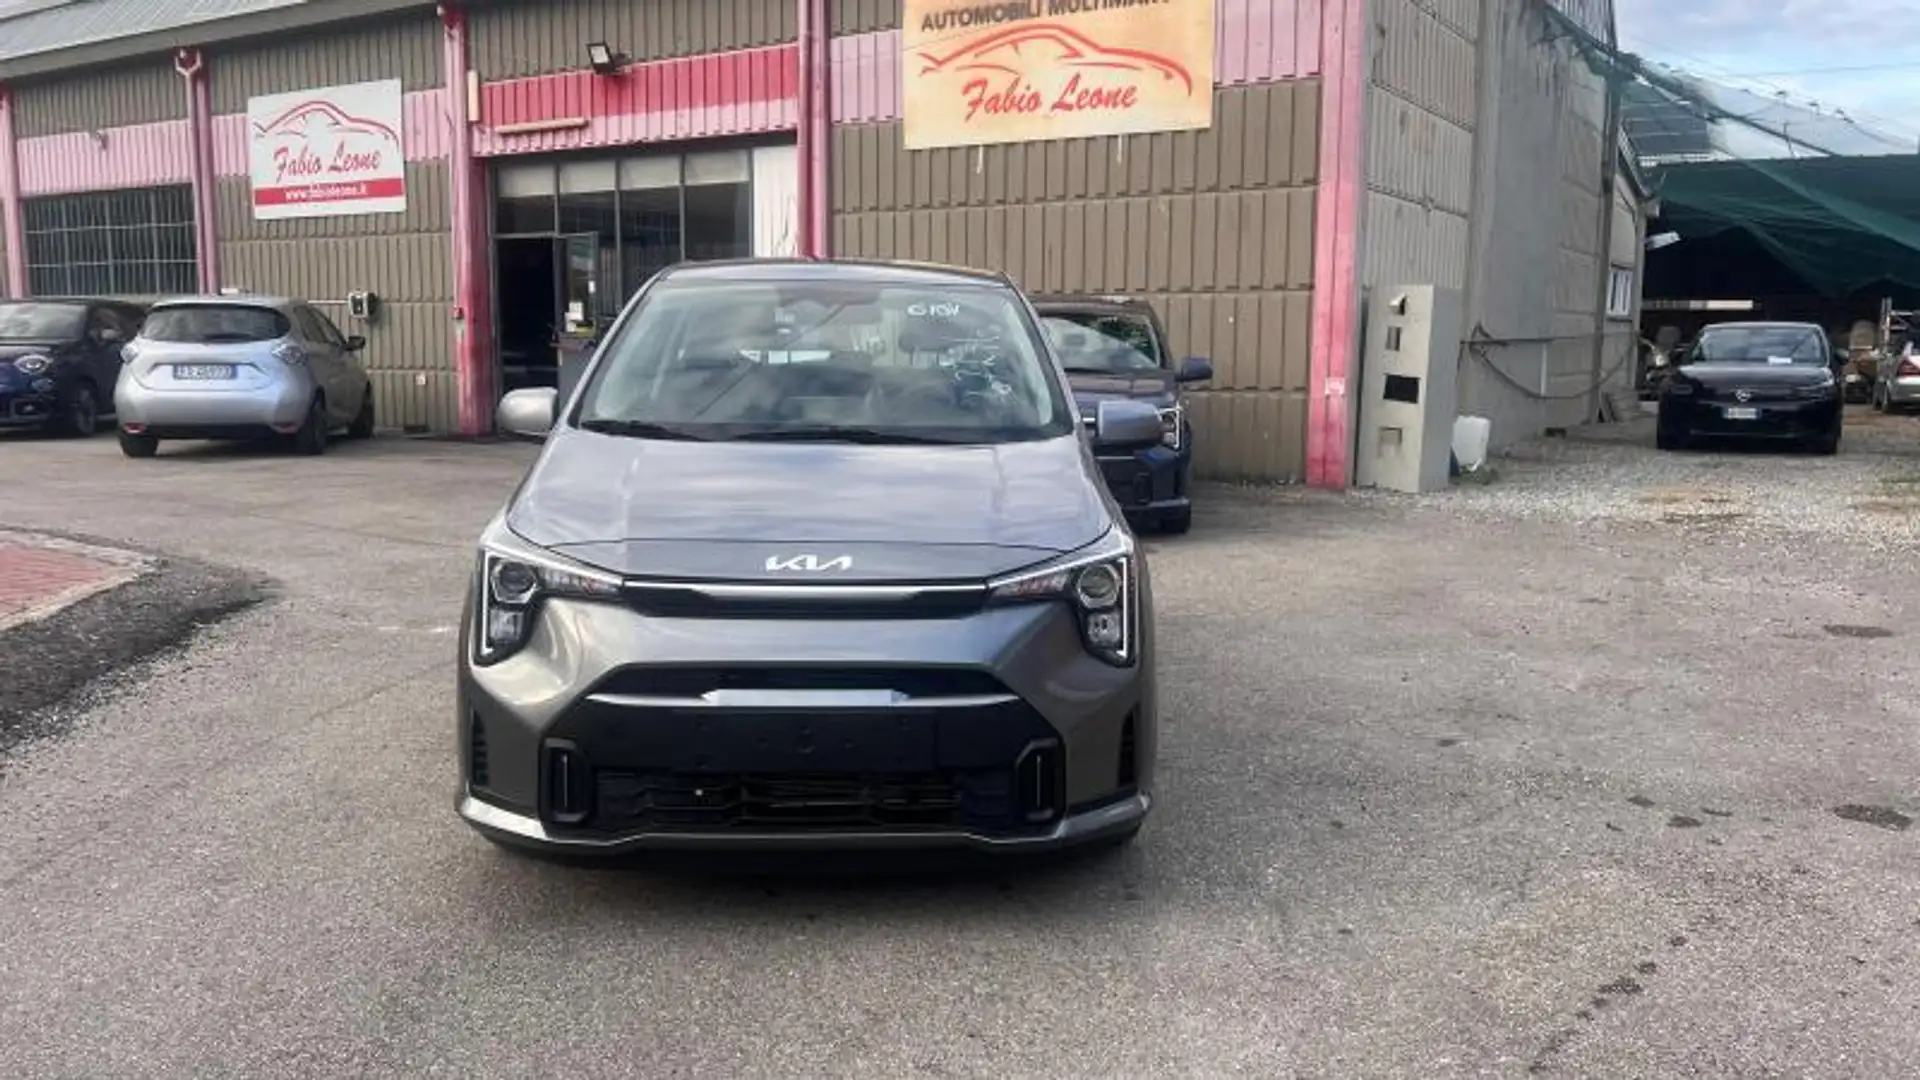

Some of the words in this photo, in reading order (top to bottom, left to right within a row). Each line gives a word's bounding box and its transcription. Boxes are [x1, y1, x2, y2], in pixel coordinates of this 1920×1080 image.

[921, 0, 1041, 32] AUTOMOBILI
[961, 76, 1043, 123] Fabio
[1050, 72, 1138, 112] Leone
[273, 145, 323, 184] Fabio
[327, 140, 382, 172] Leone
[765, 554, 854, 572] KIA
